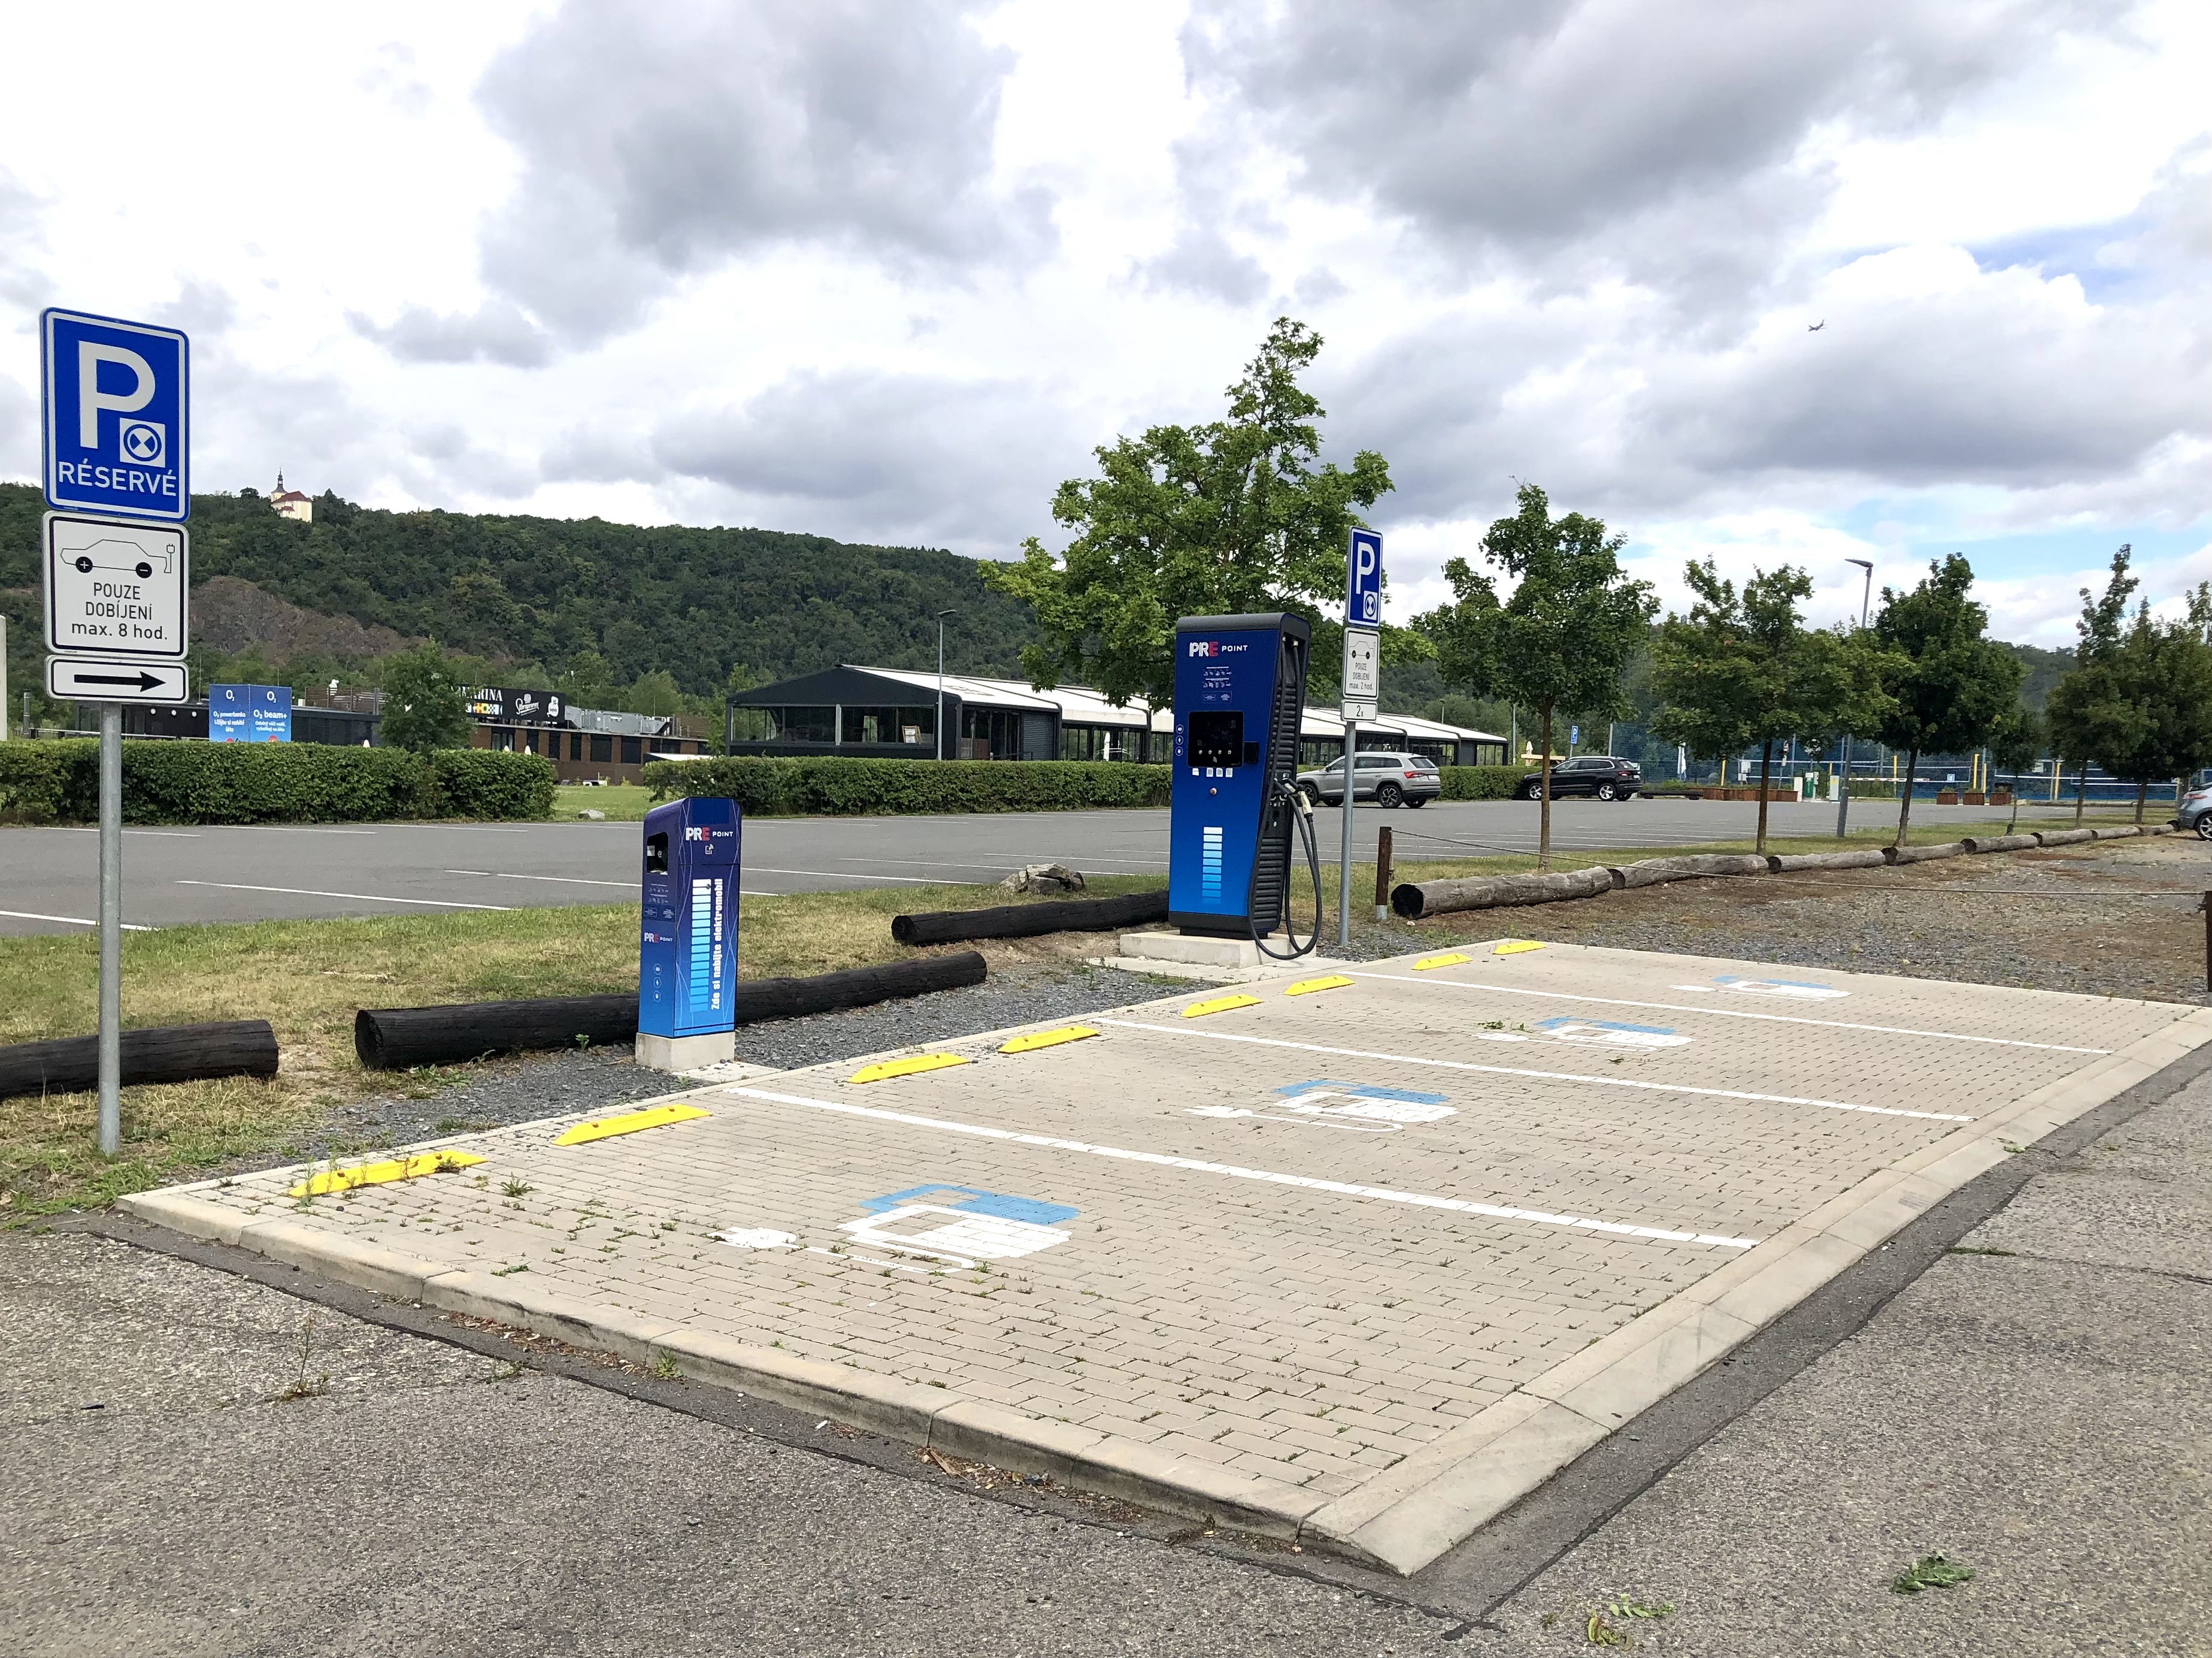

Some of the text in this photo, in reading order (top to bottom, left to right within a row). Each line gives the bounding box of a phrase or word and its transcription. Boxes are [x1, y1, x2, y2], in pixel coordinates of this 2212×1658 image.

[78, 340, 156, 449] P
[59, 458, 177, 497] RÉSERVÉ
[1356, 541, 1375, 595] P
[93, 582, 141, 600] POUZE
[85, 599, 153, 621] DOBÍJENÍ
[71, 622, 168, 640] max. 8 hod.
[1189, 641, 1218, 657] PRE
[1355, 662, 1367, 671] POUZE
[264, 710, 287, 719] beam+
[1356, 704, 1364, 718] 2x
[1572, 728, 1577, 738] P
[686, 827, 710, 842] PRE
[644, 932, 659, 943] PRE
[711, 878, 723, 1010] Zde si nabijte elektromobil
